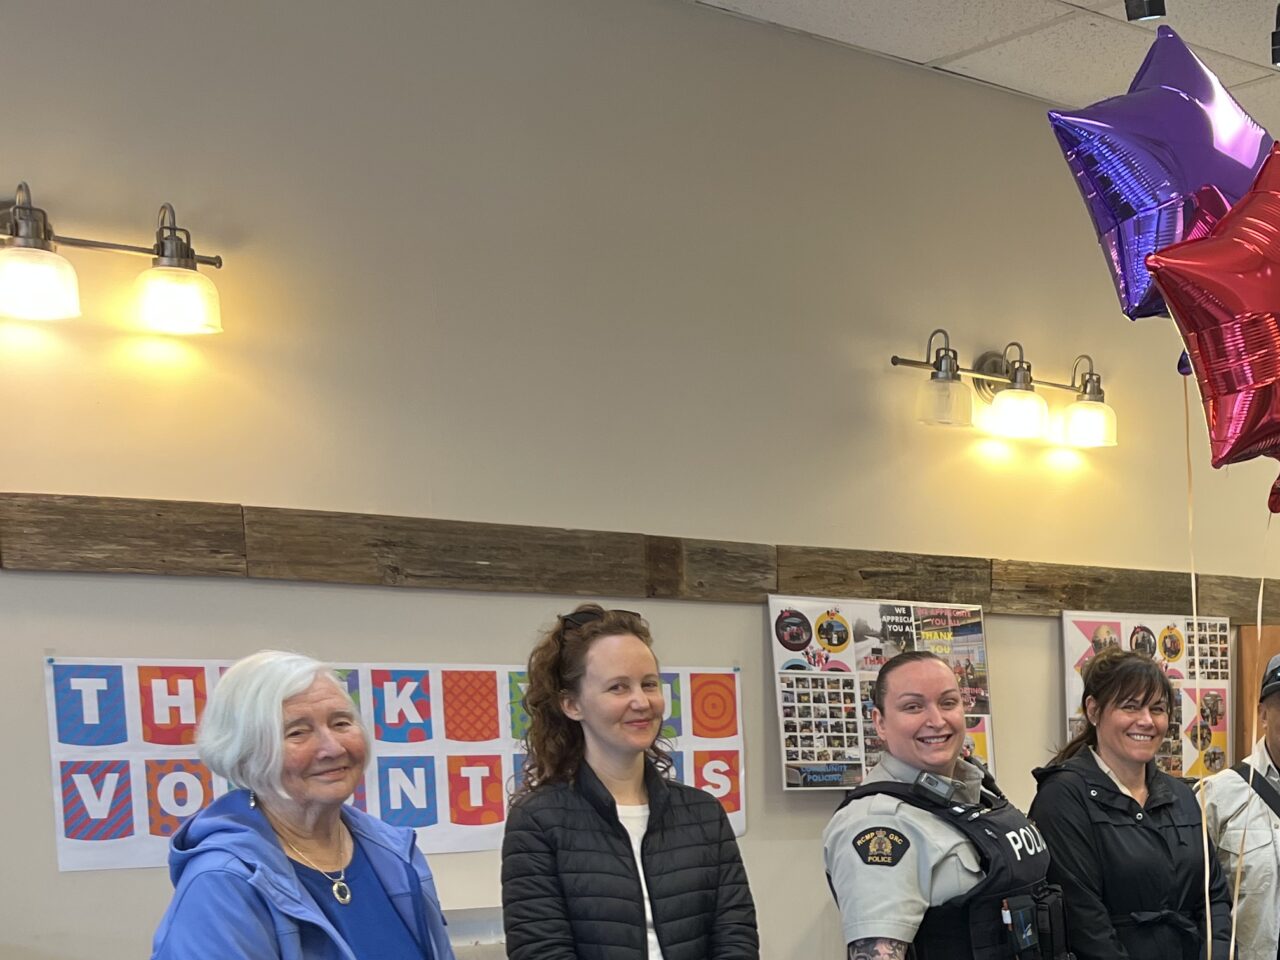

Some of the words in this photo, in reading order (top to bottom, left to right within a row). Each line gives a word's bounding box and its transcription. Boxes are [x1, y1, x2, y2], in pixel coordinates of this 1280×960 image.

[931, 618, 947, 626] YOU
[888, 624, 904, 632] YOU
[921, 631, 954, 641] THANK
[69, 677, 424, 726] THK
[807, 774, 843, 782] POLICING
[857, 832, 875, 846] RCMP
[889, 833, 903, 845] GRC
[1005, 824, 1047, 861] POLI
